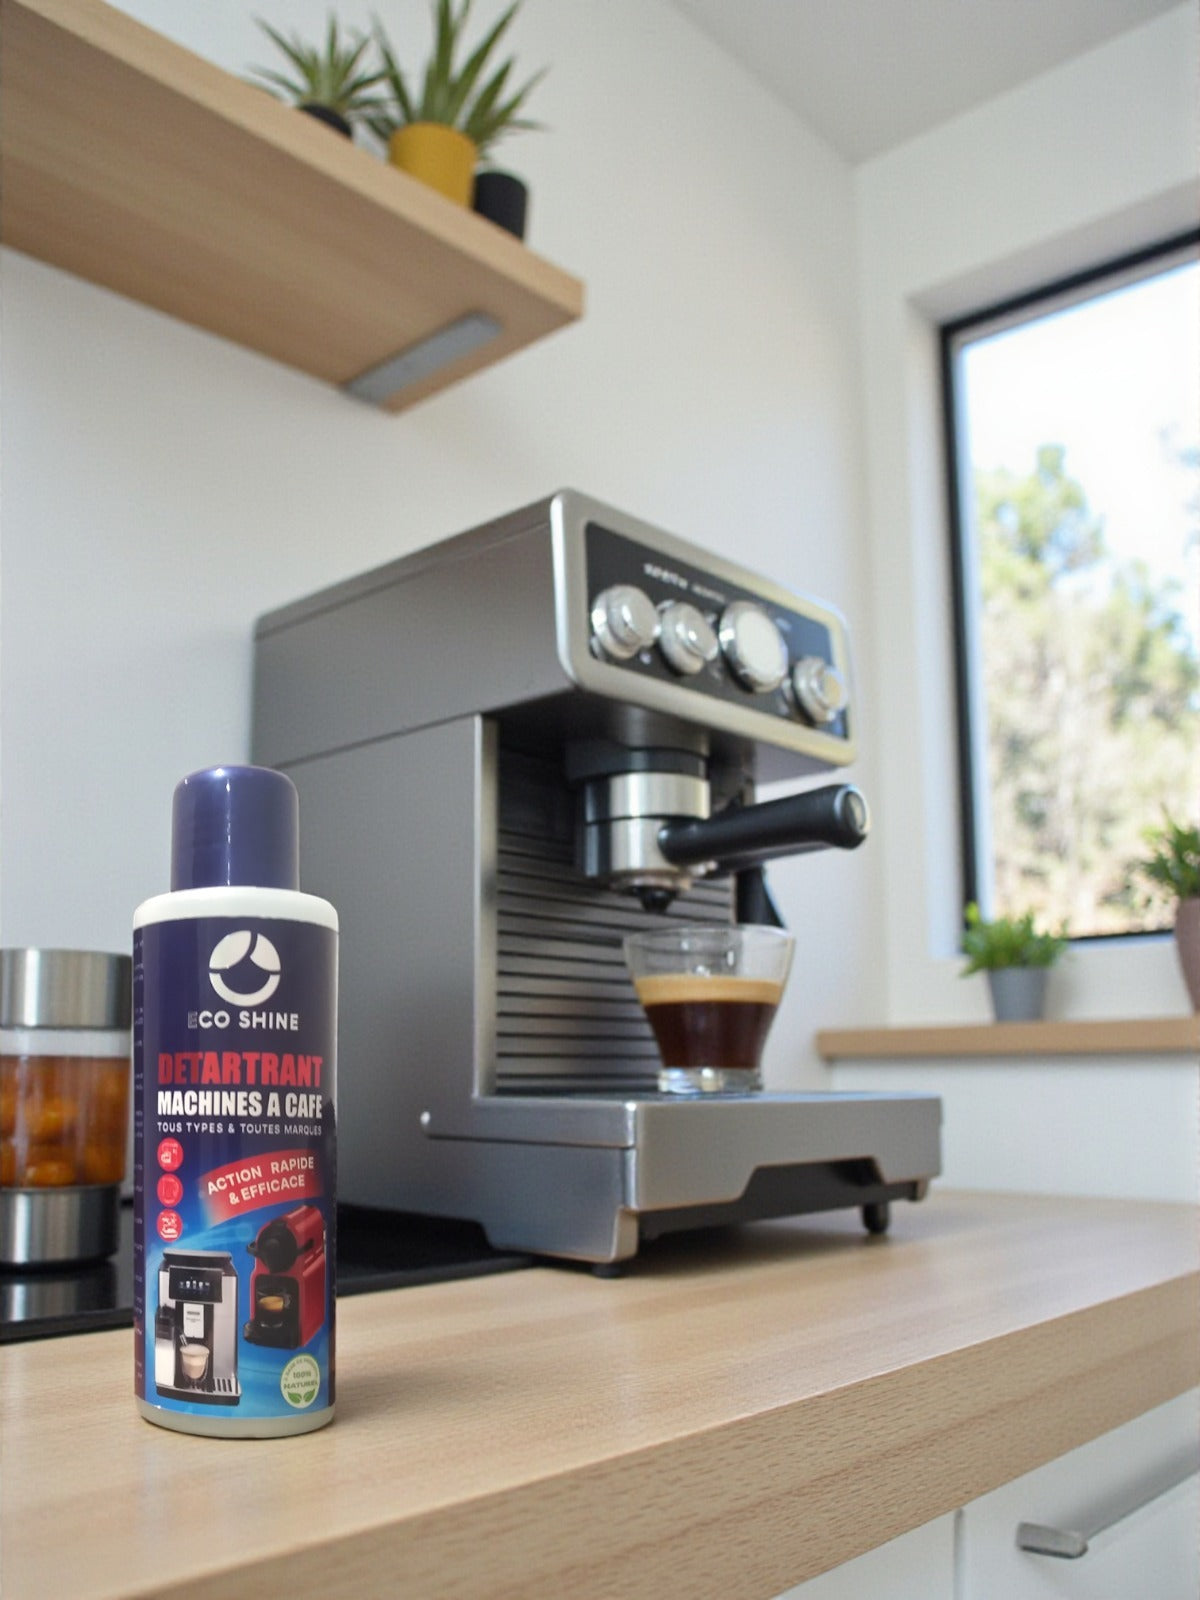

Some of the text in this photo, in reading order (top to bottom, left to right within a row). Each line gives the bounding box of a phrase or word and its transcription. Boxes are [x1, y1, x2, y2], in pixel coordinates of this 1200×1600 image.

[187, 1010, 299, 1031] ECO SHINE
[158, 1052, 322, 1087] DETARTRANT
[157, 1090, 323, 1119] MACHINES A CAFE
[157, 1121, 182, 1133] TOUS
[186, 1121, 223, 1134] TYPES
[228, 1123, 235, 1134] &
[240, 1123, 280, 1135] TOUTES
[284, 1124, 322, 1136] MARQUES
[207, 1156, 314, 1195] ACTION RAPIDE
[228, 1174, 305, 1205] & EFFICACE
